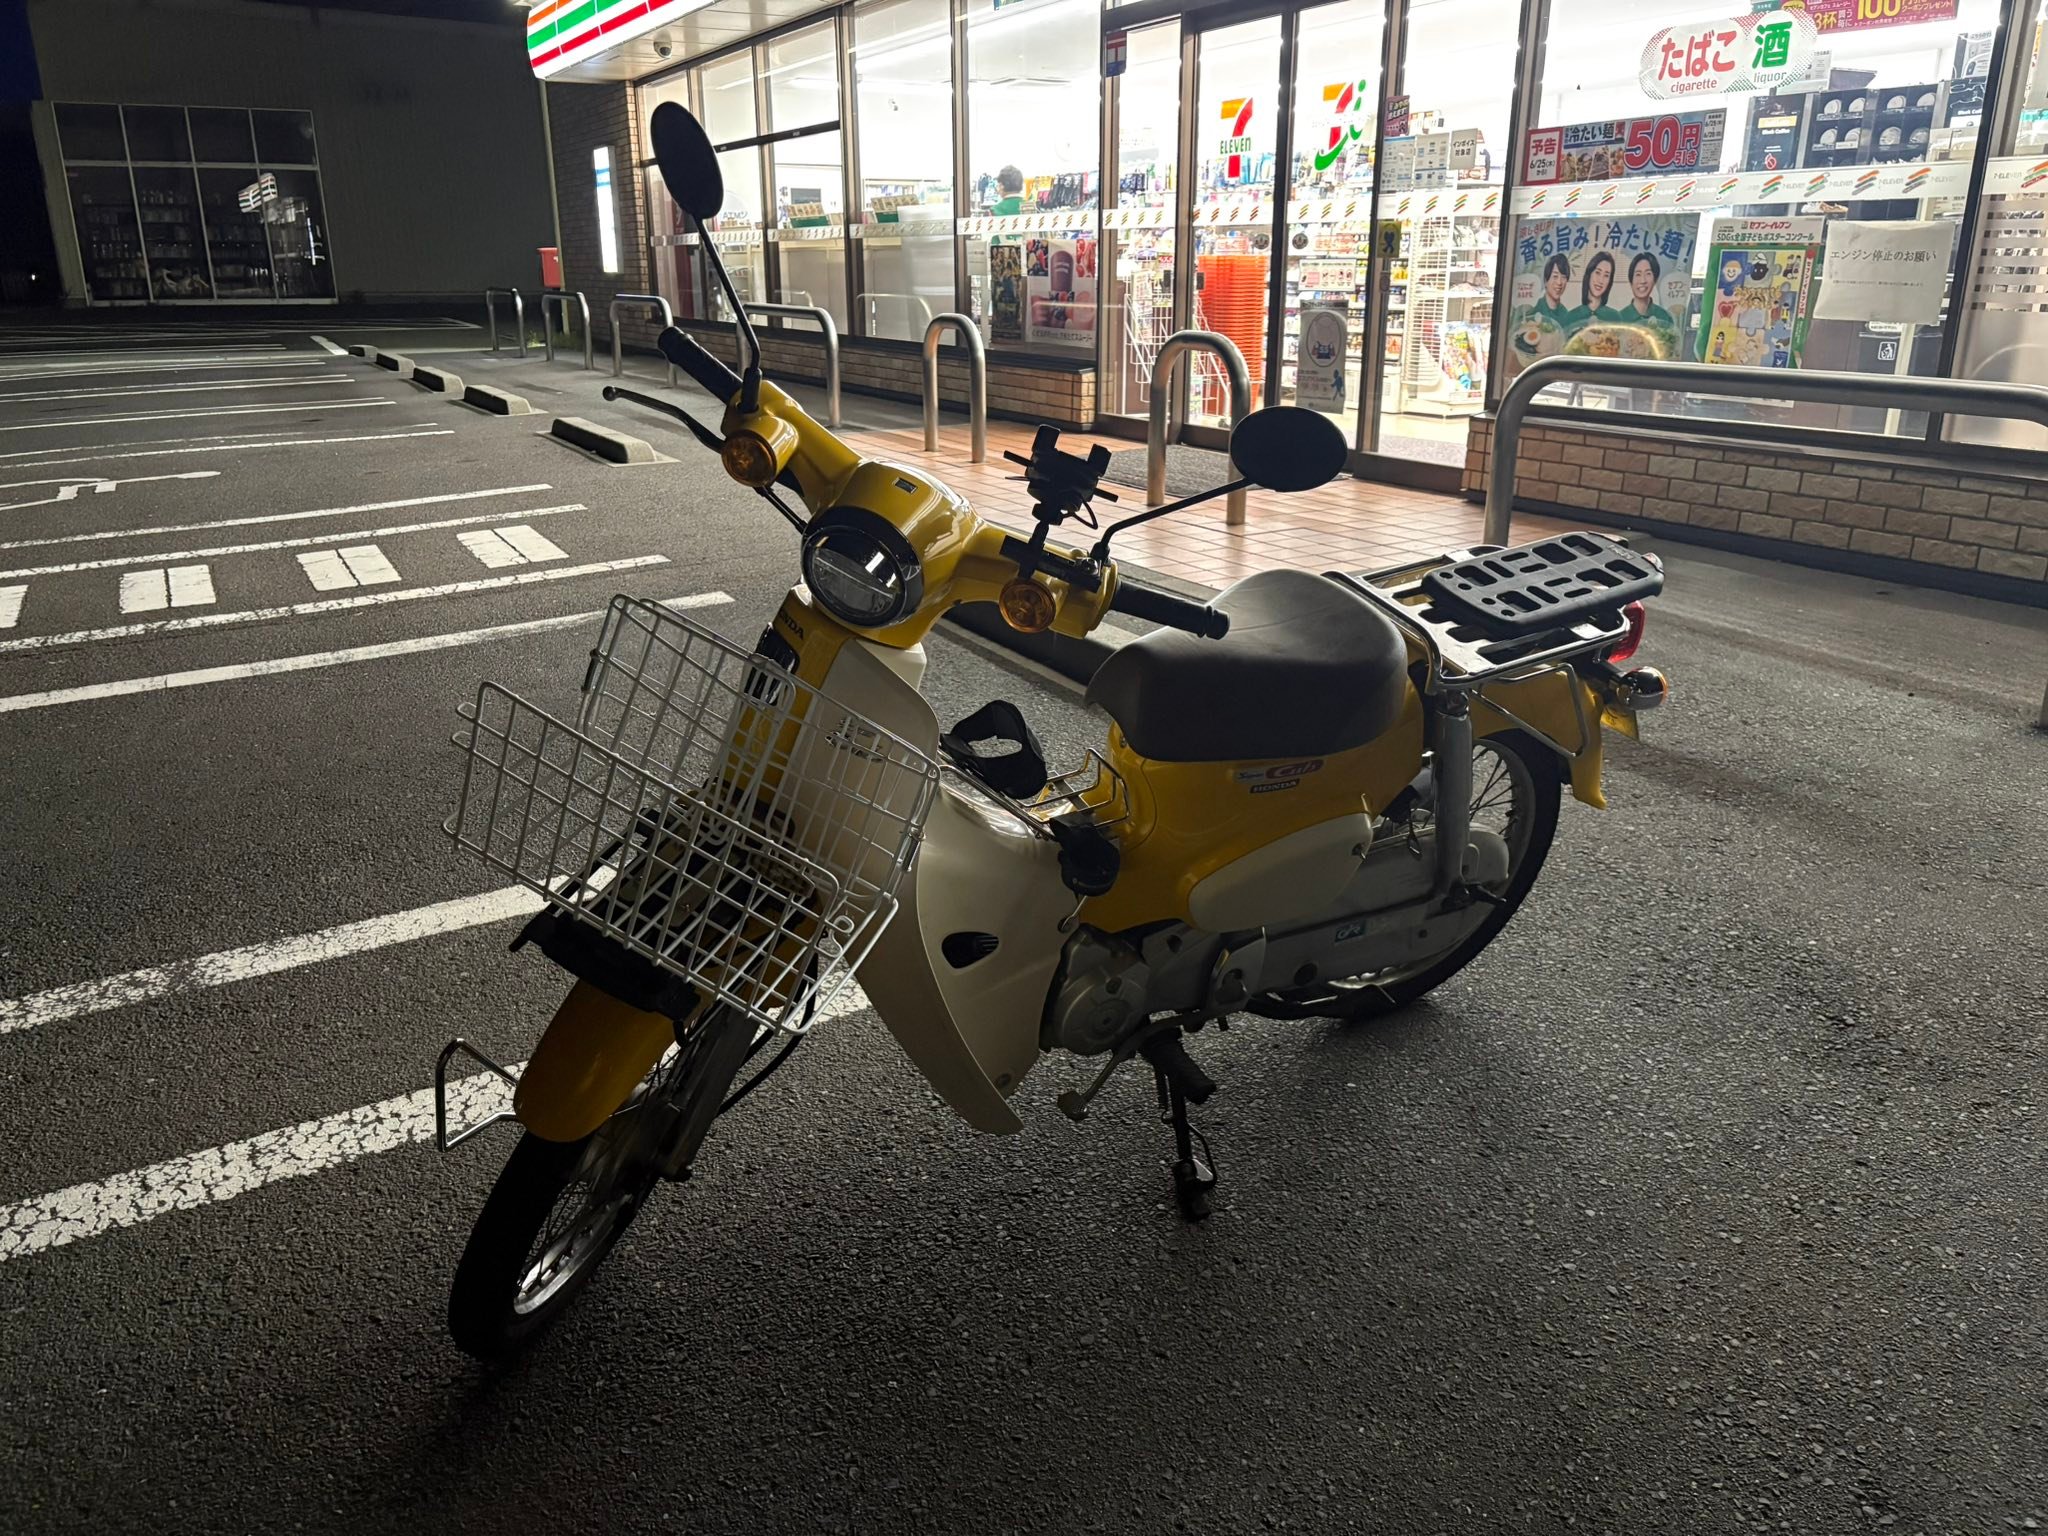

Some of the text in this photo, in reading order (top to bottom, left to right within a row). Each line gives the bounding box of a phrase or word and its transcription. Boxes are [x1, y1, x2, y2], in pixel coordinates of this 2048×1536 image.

[1752, 21, 1793, 69] 酒
[1658, 29, 1737, 81] たばこ
[1670, 76, 1718, 94] cigarette
[1753, 70, 1787, 85] liquor
[1568, 122, 1615, 143] 冷たい麺
[1531, 137, 1557, 156] 予告
[1674, 149, 1698, 167] 引き
[1829, 248, 1938, 263] エンジン停止のお願い
[1252, 779, 1298, 793] HONDA
